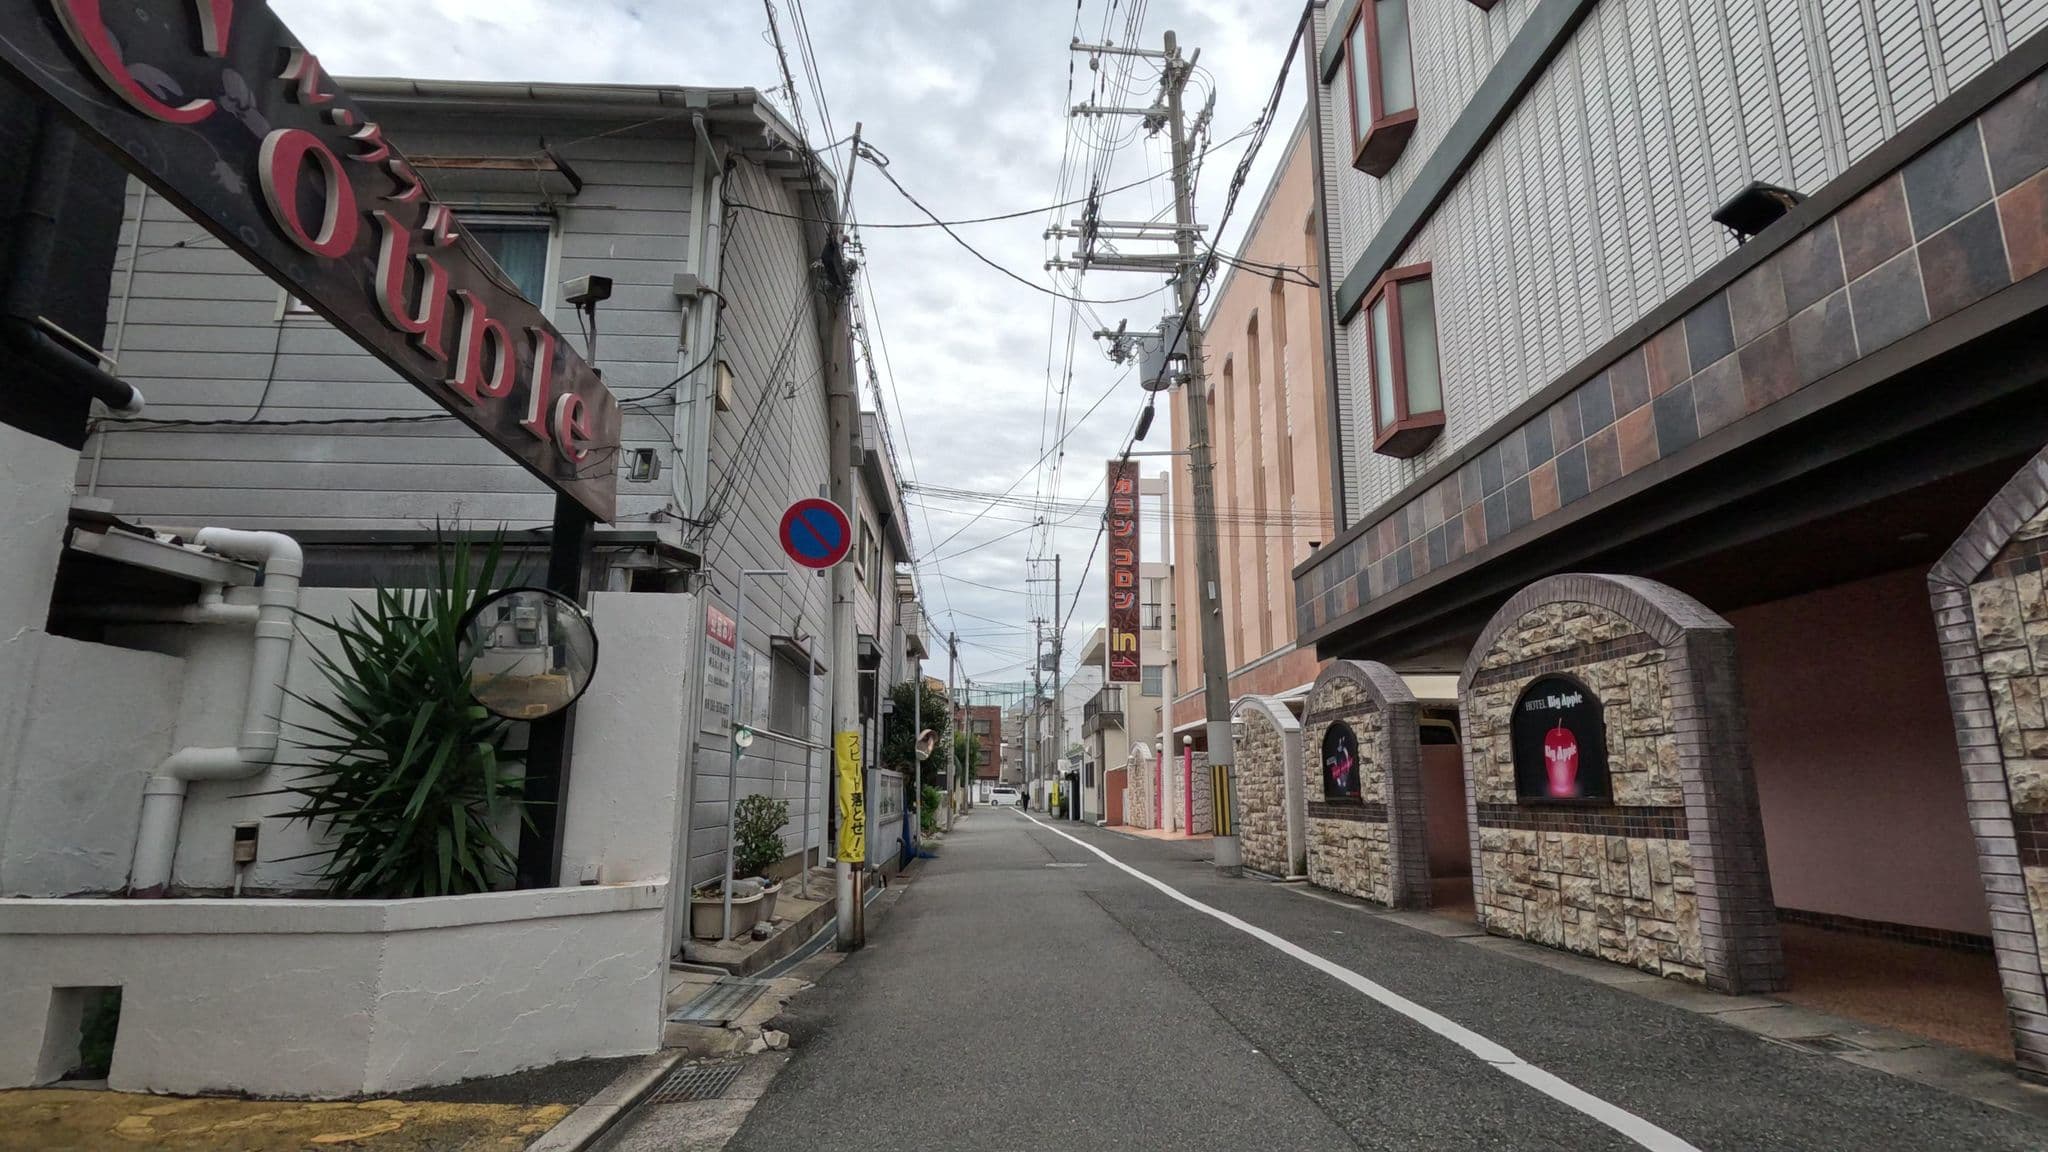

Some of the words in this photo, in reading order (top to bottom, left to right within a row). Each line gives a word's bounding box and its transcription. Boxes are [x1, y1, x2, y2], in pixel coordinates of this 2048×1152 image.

[1112, 628, 1136, 651] in
[1525, 699, 1547, 711] HOTEL
[1547, 695, 1561, 709] Big
[1561, 691, 1583, 708] Apple
[1557, 742, 1577, 762] Apple
